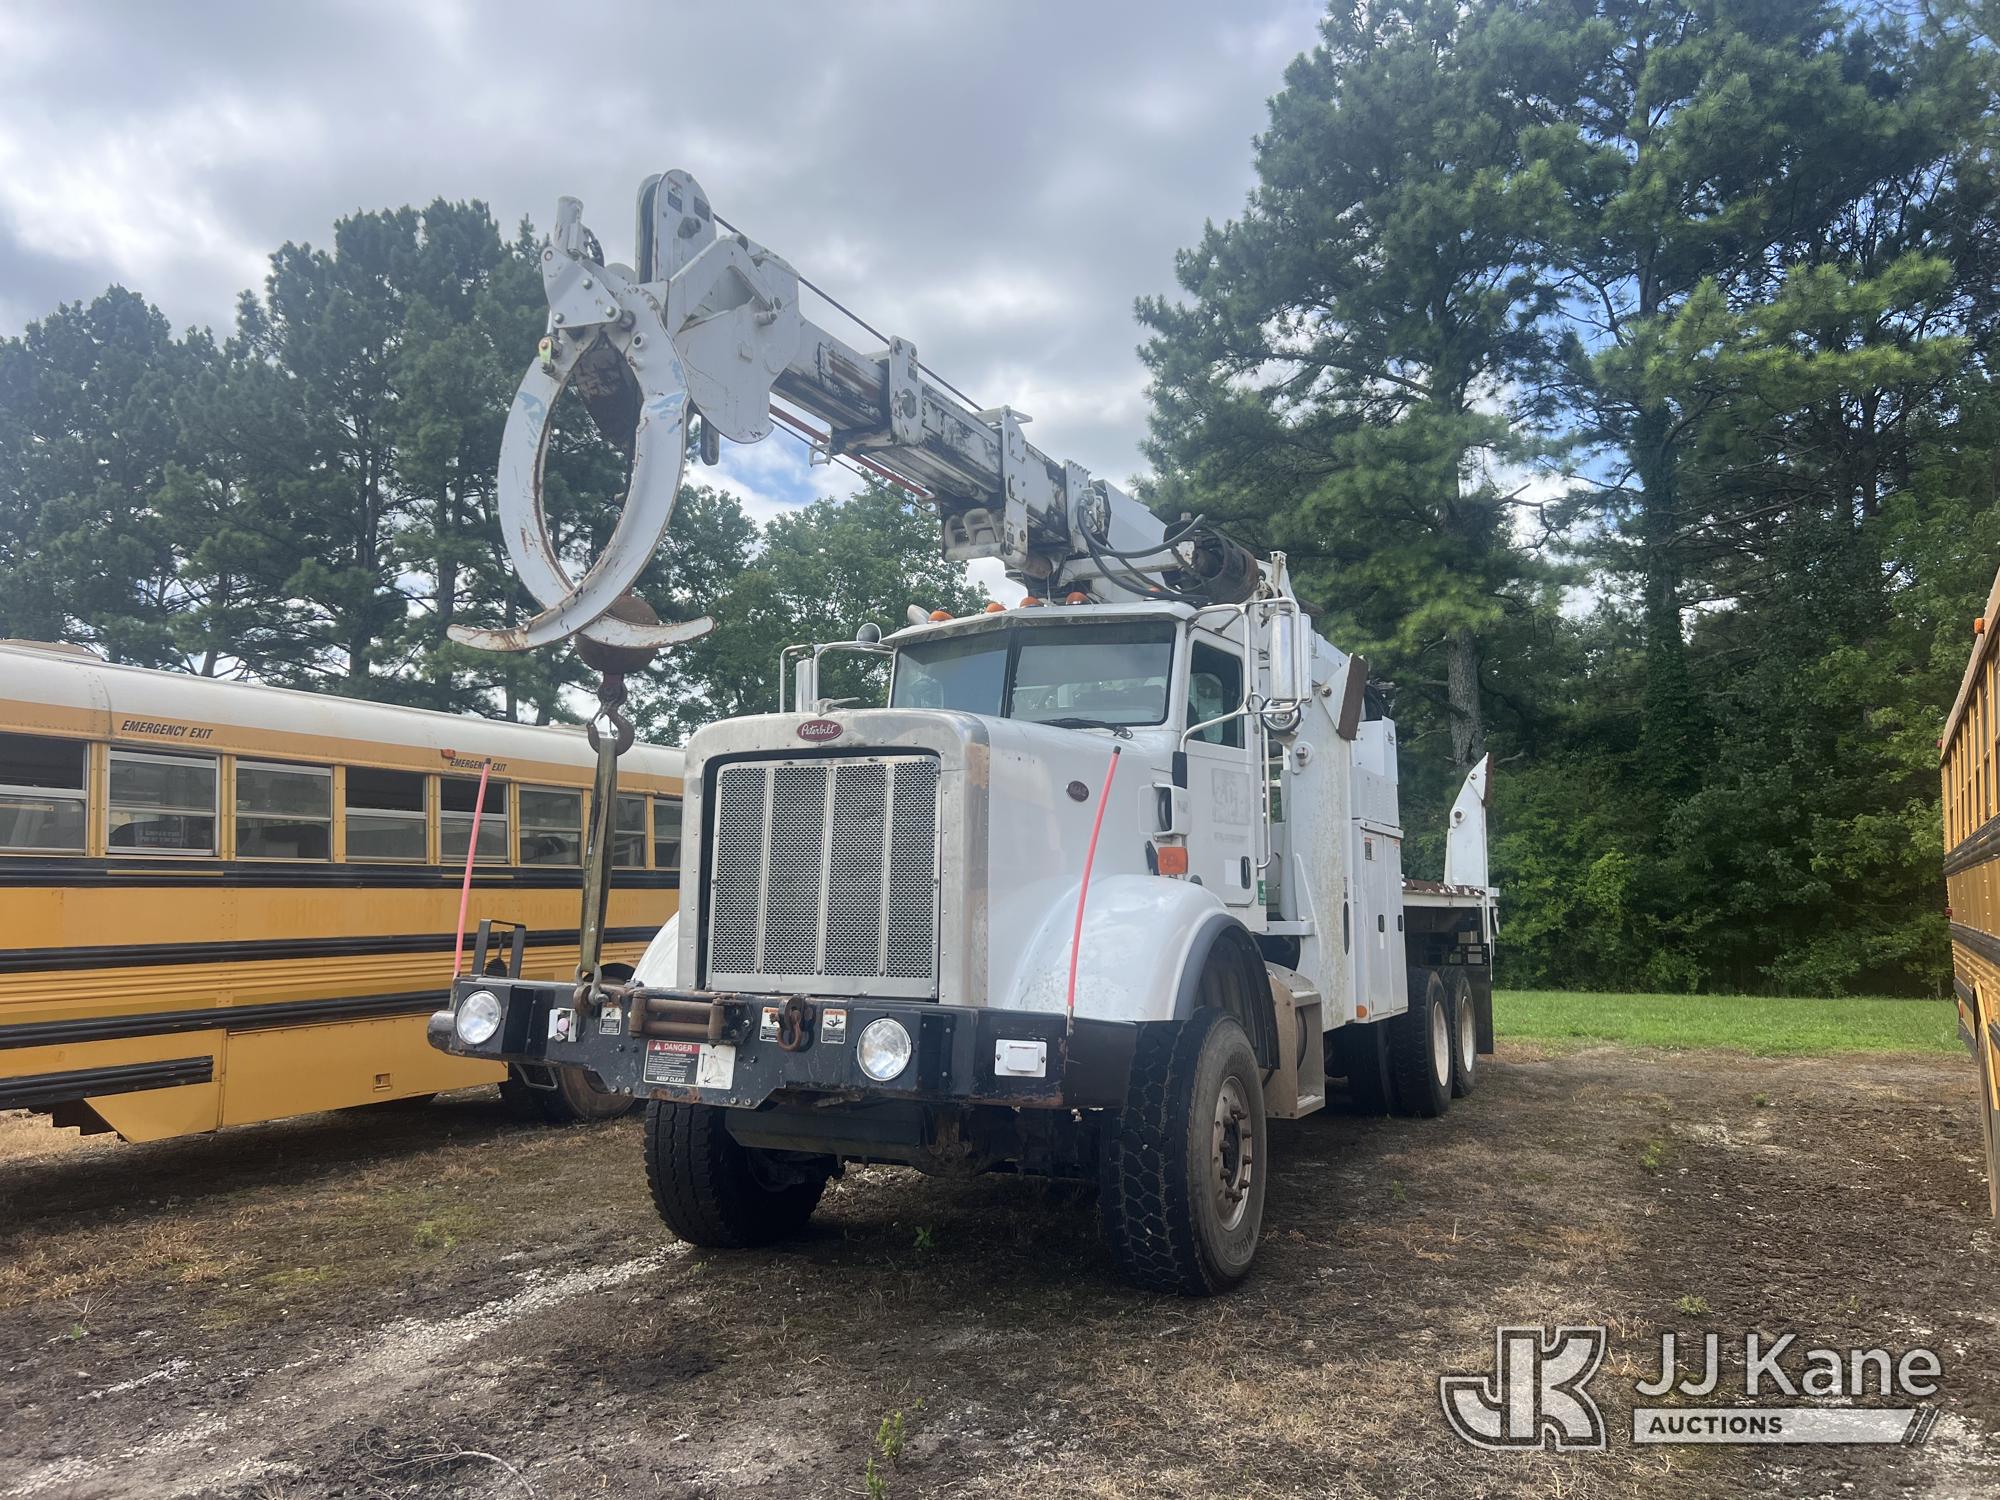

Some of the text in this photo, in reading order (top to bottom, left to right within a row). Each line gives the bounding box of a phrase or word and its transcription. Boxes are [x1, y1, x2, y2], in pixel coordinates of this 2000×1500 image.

[121, 720, 214, 739] EMERGENCY EXIT
[801, 723, 838, 736] Peterbilt
[450, 758, 507, 772] EMERGEN EXIT
[664, 1044, 693, 1052] DANGER
